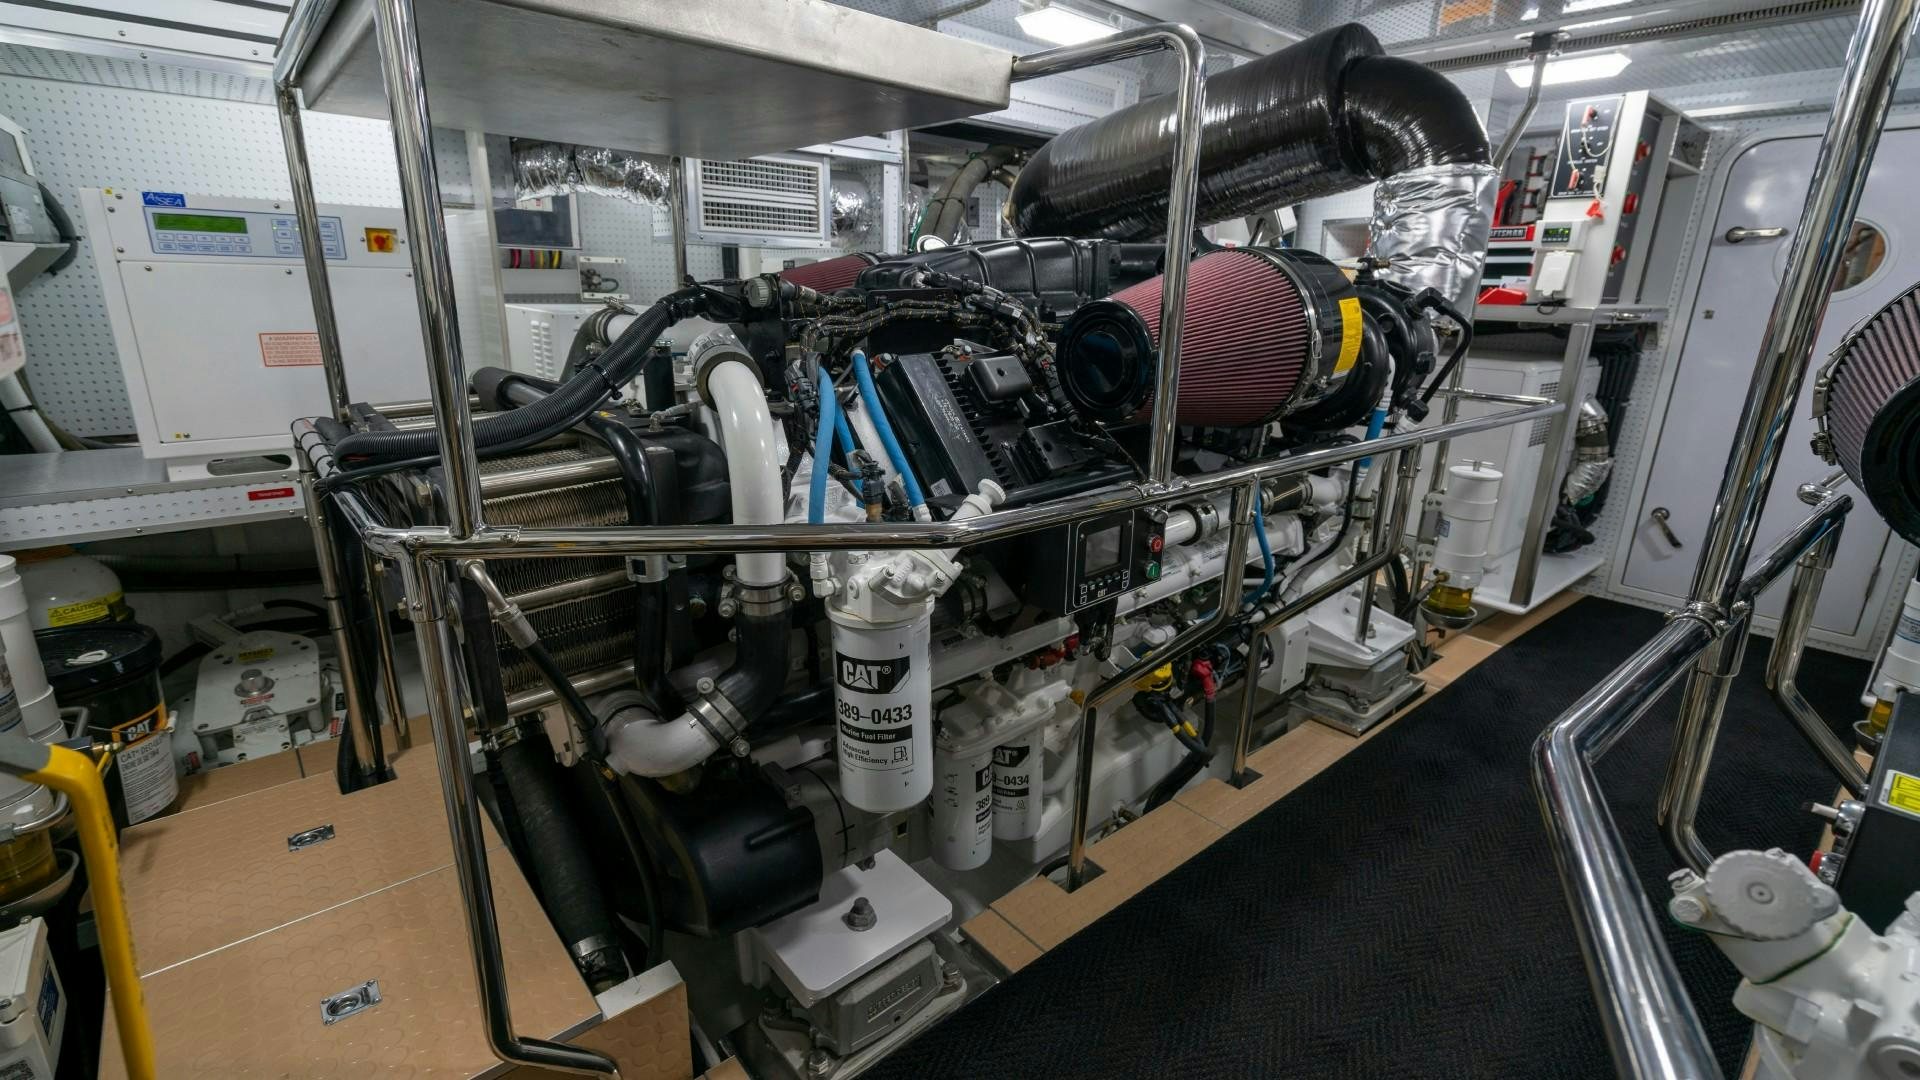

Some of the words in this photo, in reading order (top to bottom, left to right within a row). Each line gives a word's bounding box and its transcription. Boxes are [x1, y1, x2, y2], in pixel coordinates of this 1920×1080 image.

[1490, 229, 1524, 238] AFTSMAN
[63, 602, 103, 615] CAUTION
[877, 733, 896, 741] Filter
[842, 741, 870, 756] Advanced
[855, 753, 888, 766] Efficiency
